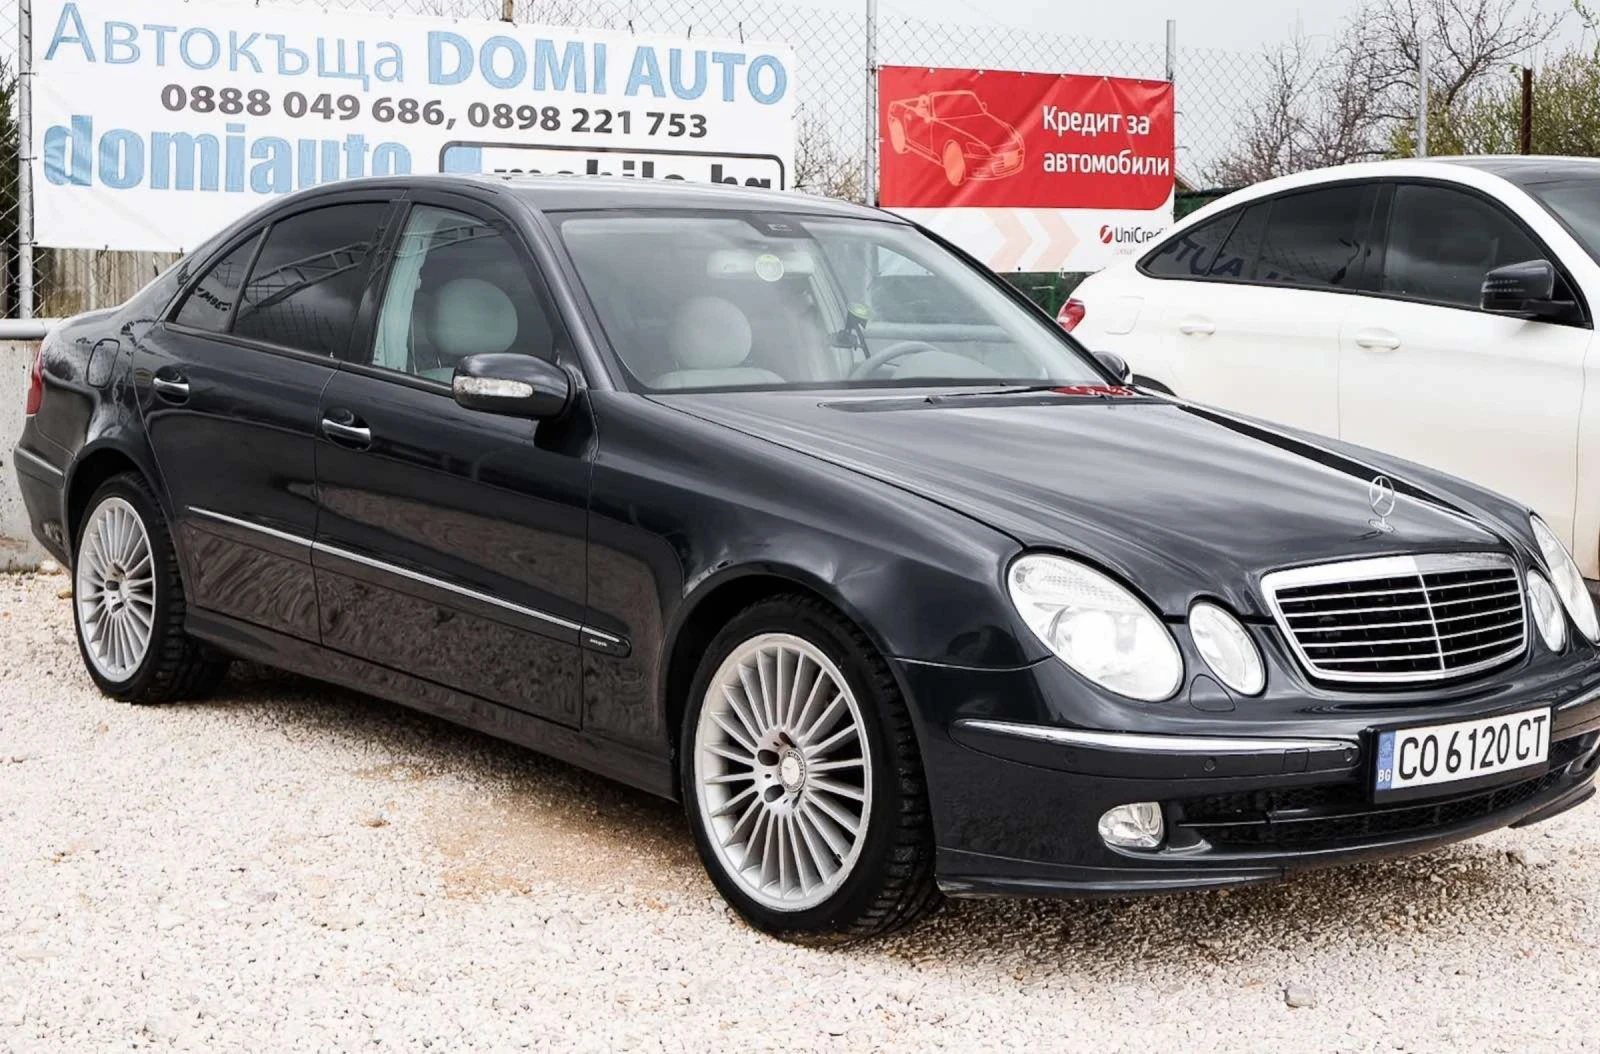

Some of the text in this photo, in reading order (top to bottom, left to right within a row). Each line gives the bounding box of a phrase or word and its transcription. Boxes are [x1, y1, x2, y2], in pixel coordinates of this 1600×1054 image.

[44, 2, 787, 104] Автокъща DOMI AUTO
[161, 84, 707, 138] 0888 049 686, 0898 221 753
[1043, 105, 1151, 137] Кредит за
[43, 115, 412, 194] domiauto
[1043, 149, 1169, 176] автомобили
[1398, 715, 1547, 781] CO 6120 CT
[1377, 768, 1392, 783] BG
